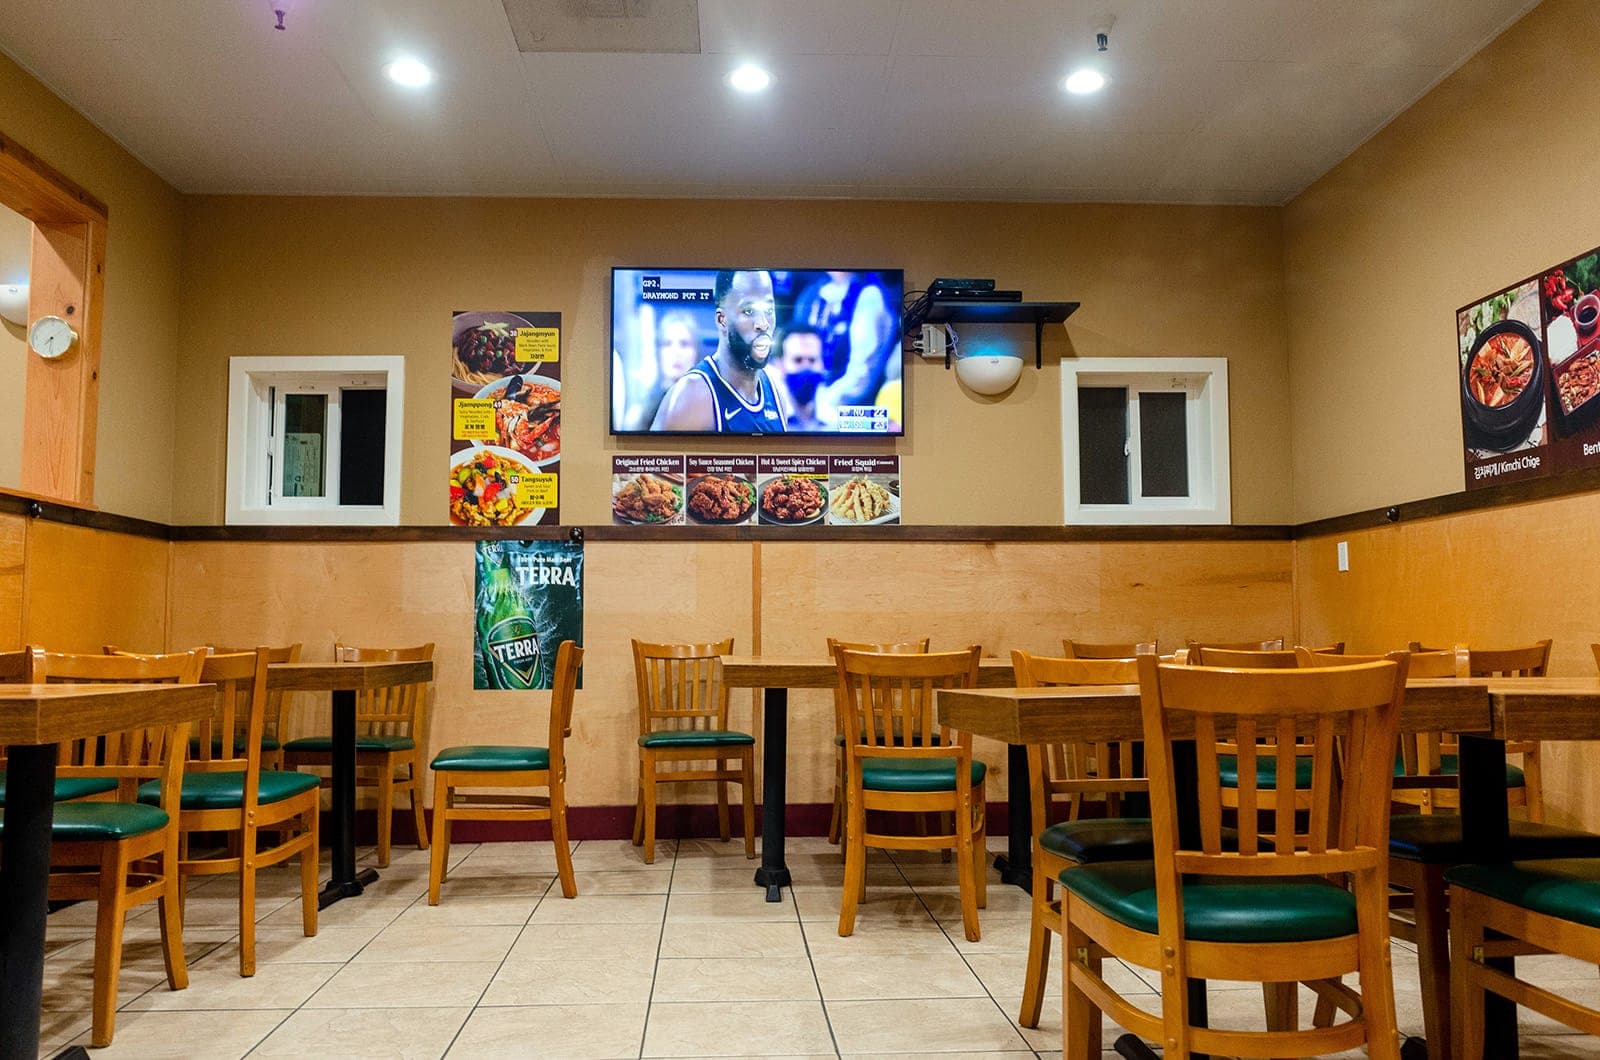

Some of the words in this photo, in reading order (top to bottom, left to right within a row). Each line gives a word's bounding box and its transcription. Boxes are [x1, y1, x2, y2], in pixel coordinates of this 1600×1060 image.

[643, 292, 679, 300] DRAYMOND
[682, 292, 696, 300] PUT
[700, 292, 710, 300] IT
[873, 409, 886, 417] 22
[616, 458, 639, 467] Original
[689, 458, 698, 466] Soy
[792, 458, 805, 467] Spicy
[855, 458, 876, 467] Squid
[1501, 458, 1521, 473] Kimchi
[1522, 455, 1540, 469] Chige
[515, 566, 576, 587] TERRA
[493, 637, 540, 663] TERRA
